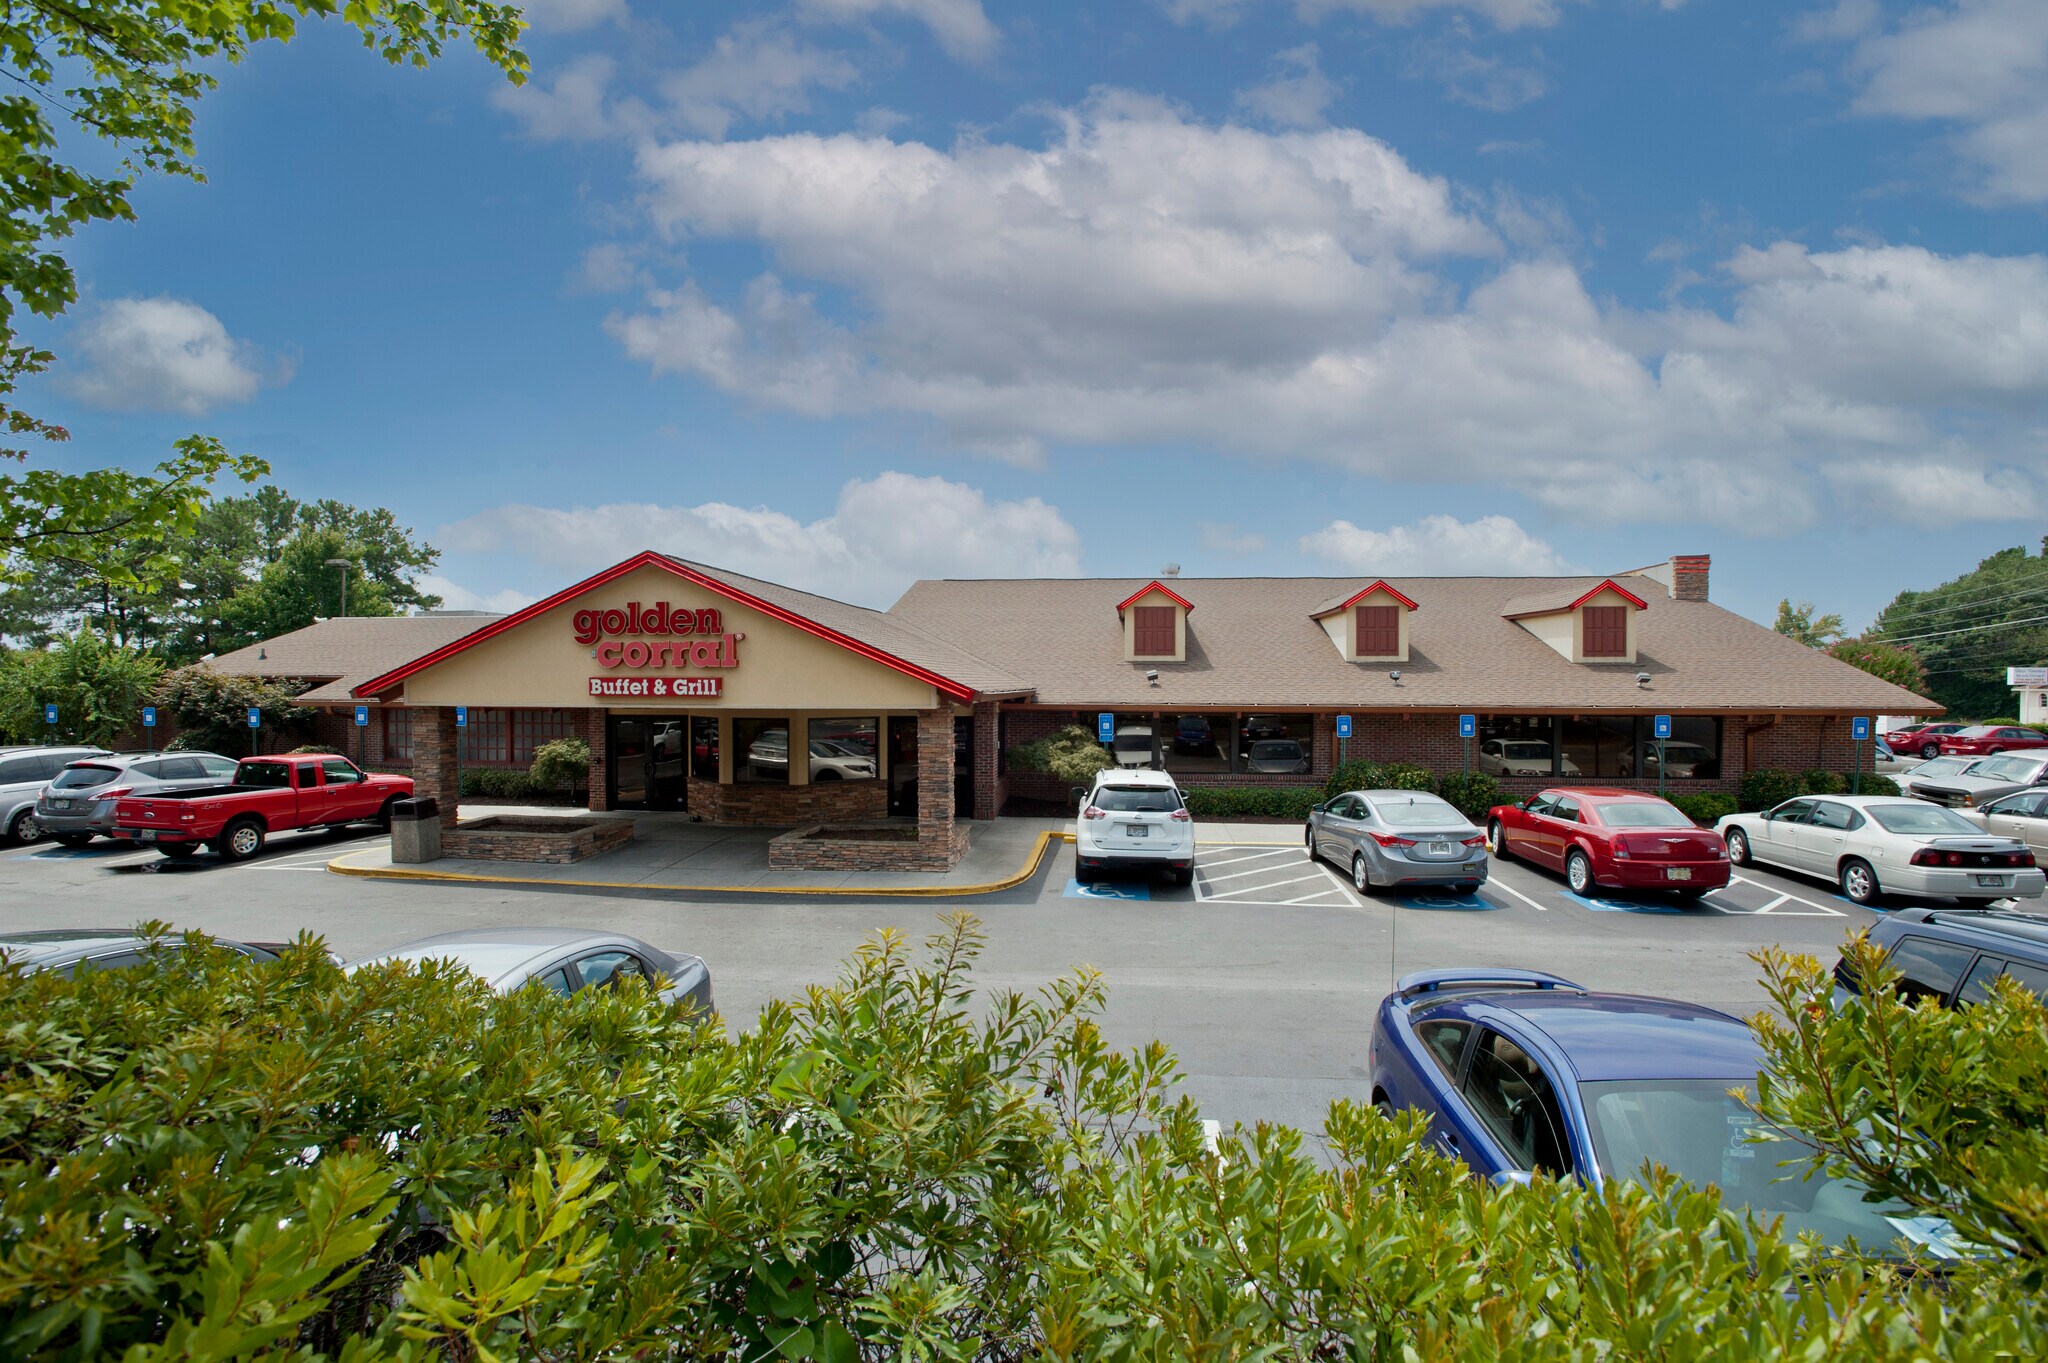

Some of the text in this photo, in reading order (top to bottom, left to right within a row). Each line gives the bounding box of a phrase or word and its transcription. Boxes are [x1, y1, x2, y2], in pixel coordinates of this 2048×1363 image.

[573, 602, 723, 645] golden
[590, 678, 717, 695] Buffet & Grill
